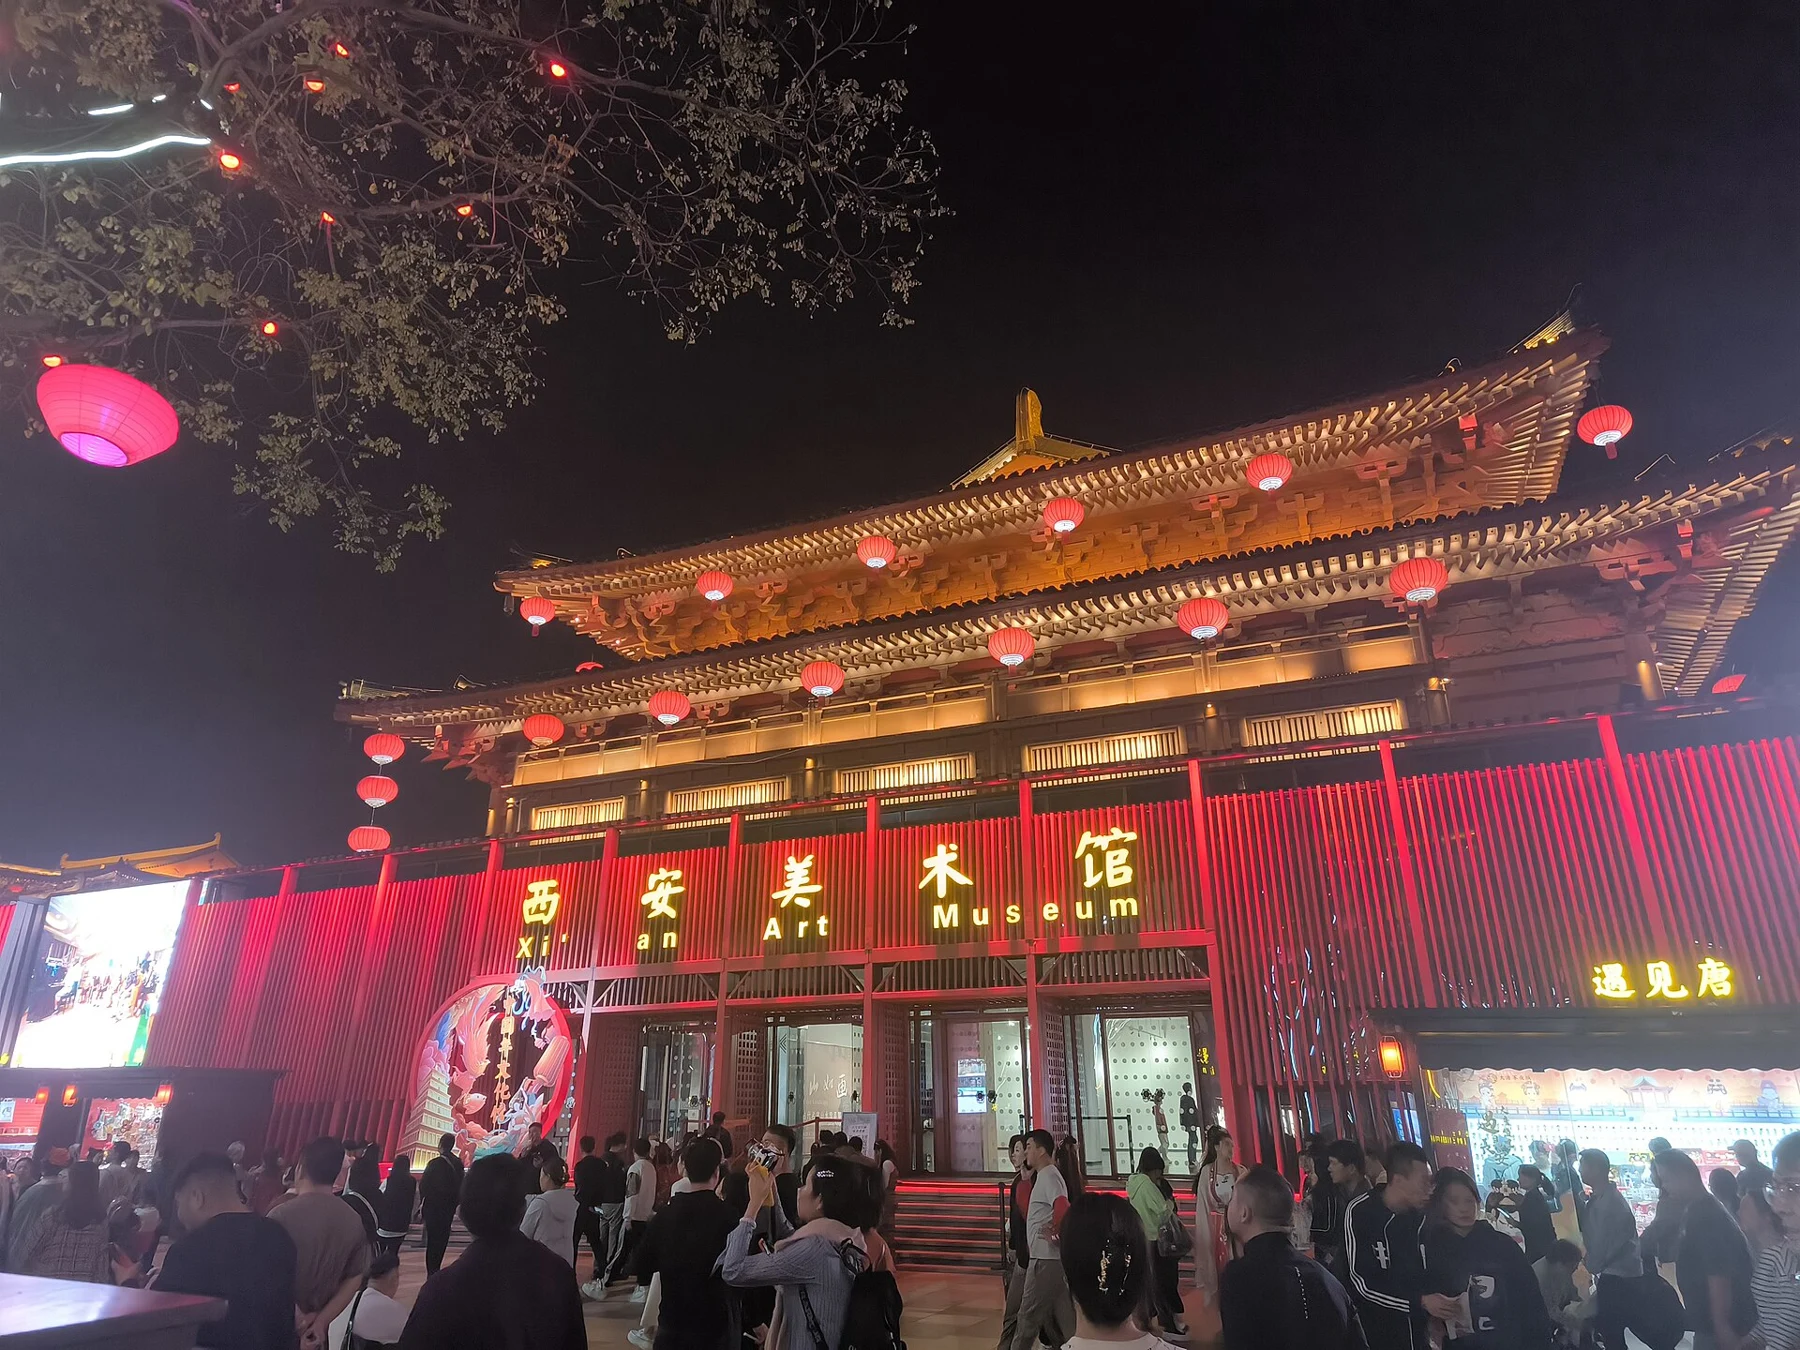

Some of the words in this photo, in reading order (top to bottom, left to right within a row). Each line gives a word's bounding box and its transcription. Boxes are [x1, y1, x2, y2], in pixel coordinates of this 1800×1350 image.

[522, 826, 1138, 925] 西安美术馆
[762, 914, 829, 941] Art
[933, 896, 1139, 929] Museum
[1591, 957, 1732, 999] 遇见唐
